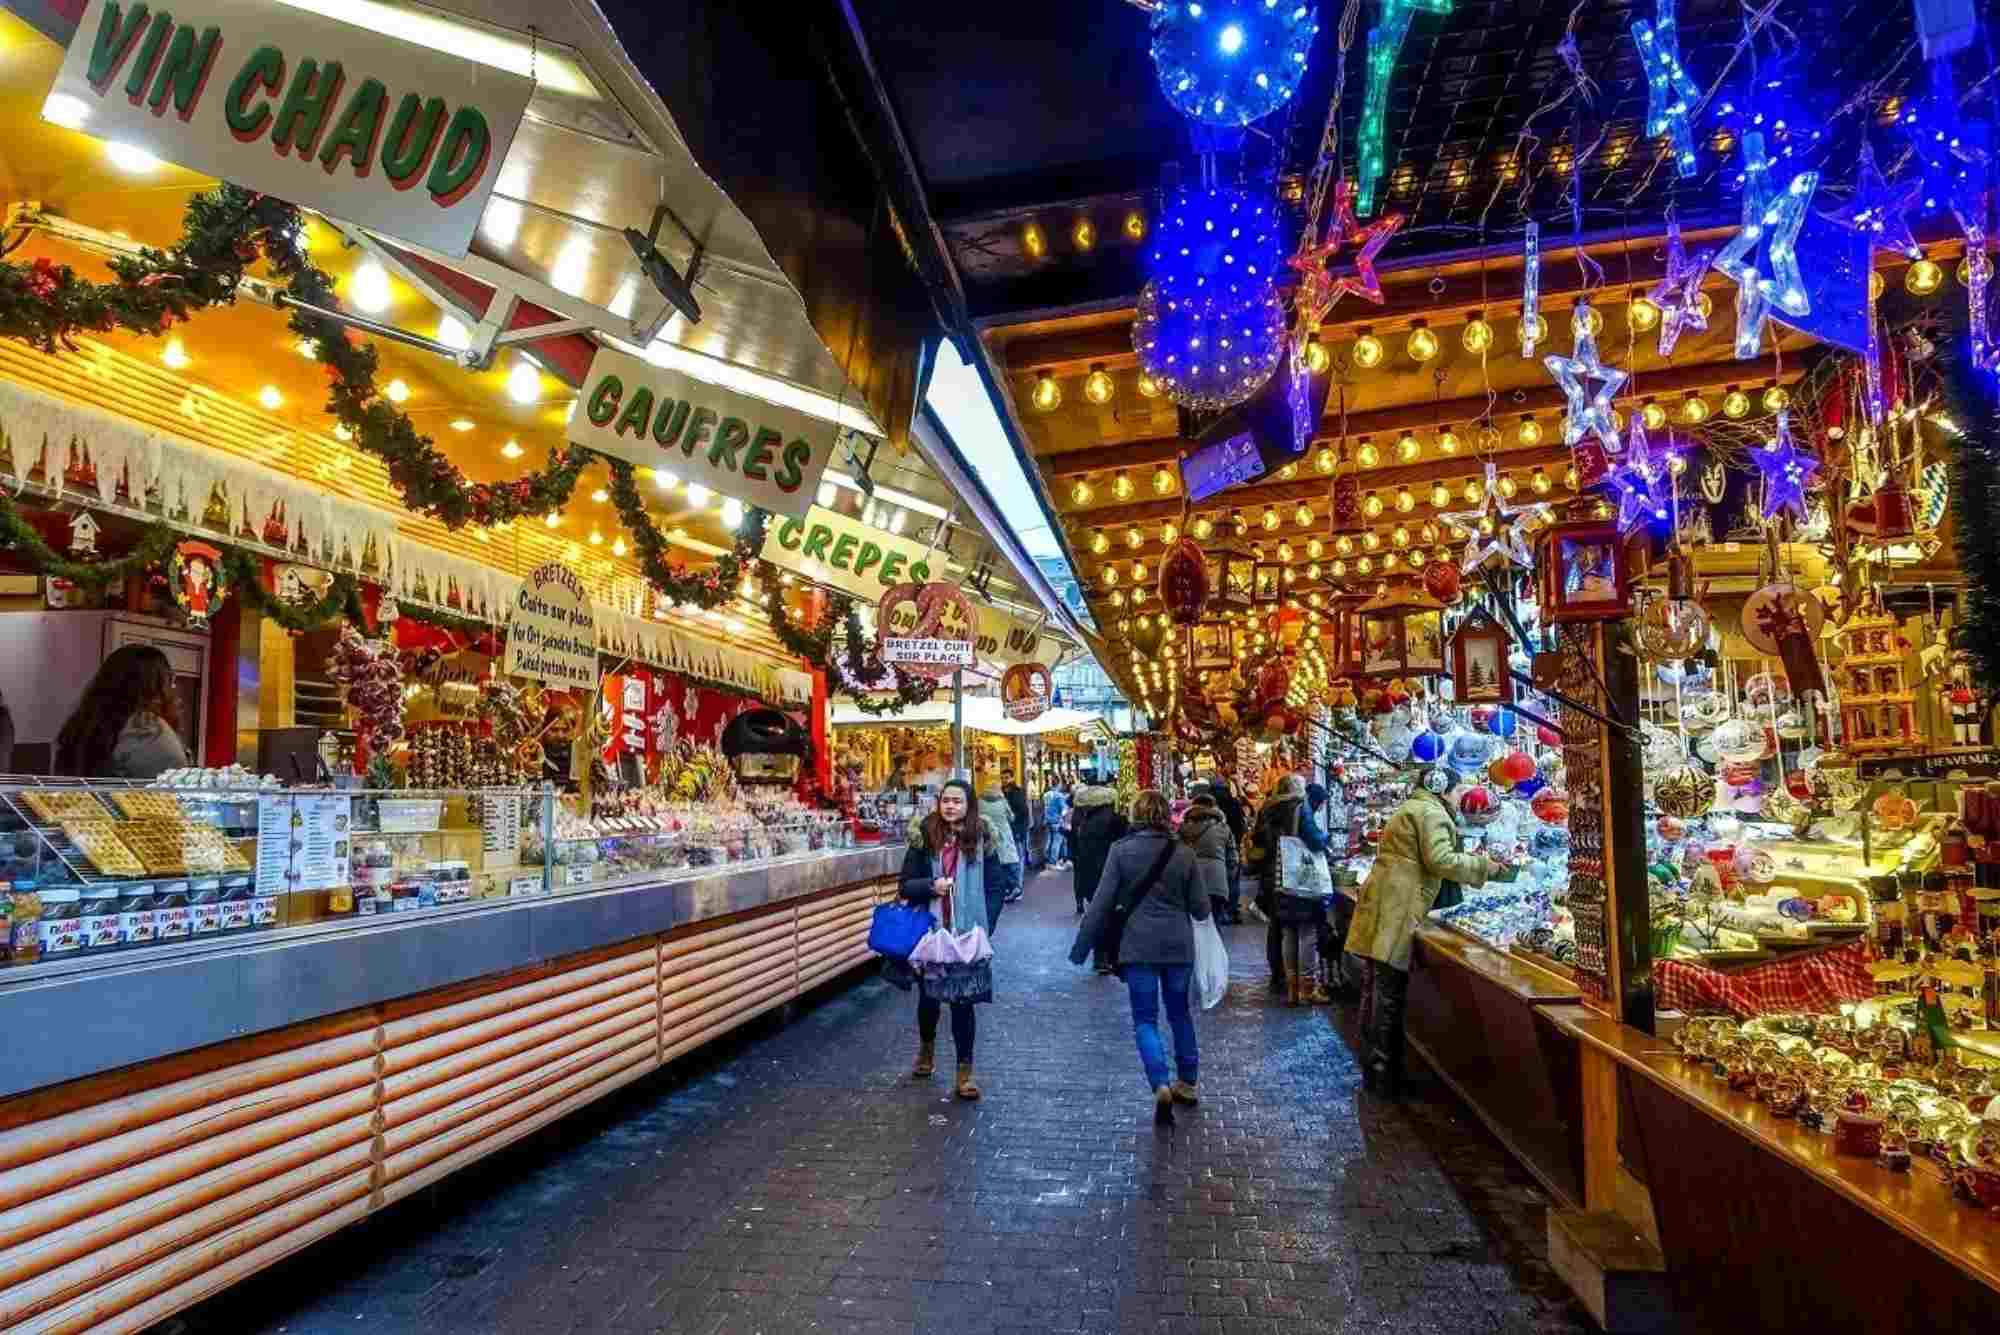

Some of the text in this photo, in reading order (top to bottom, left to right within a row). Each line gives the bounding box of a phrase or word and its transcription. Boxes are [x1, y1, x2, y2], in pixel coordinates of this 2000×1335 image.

[86, 1, 490, 208] VIN CHAUD
[586, 373, 813, 493] GAUFRES
[777, 514, 931, 588] CREPES
[886, 638, 970, 653] BRETZEL CUIT
[895, 651, 962, 663] SUR PLACE
